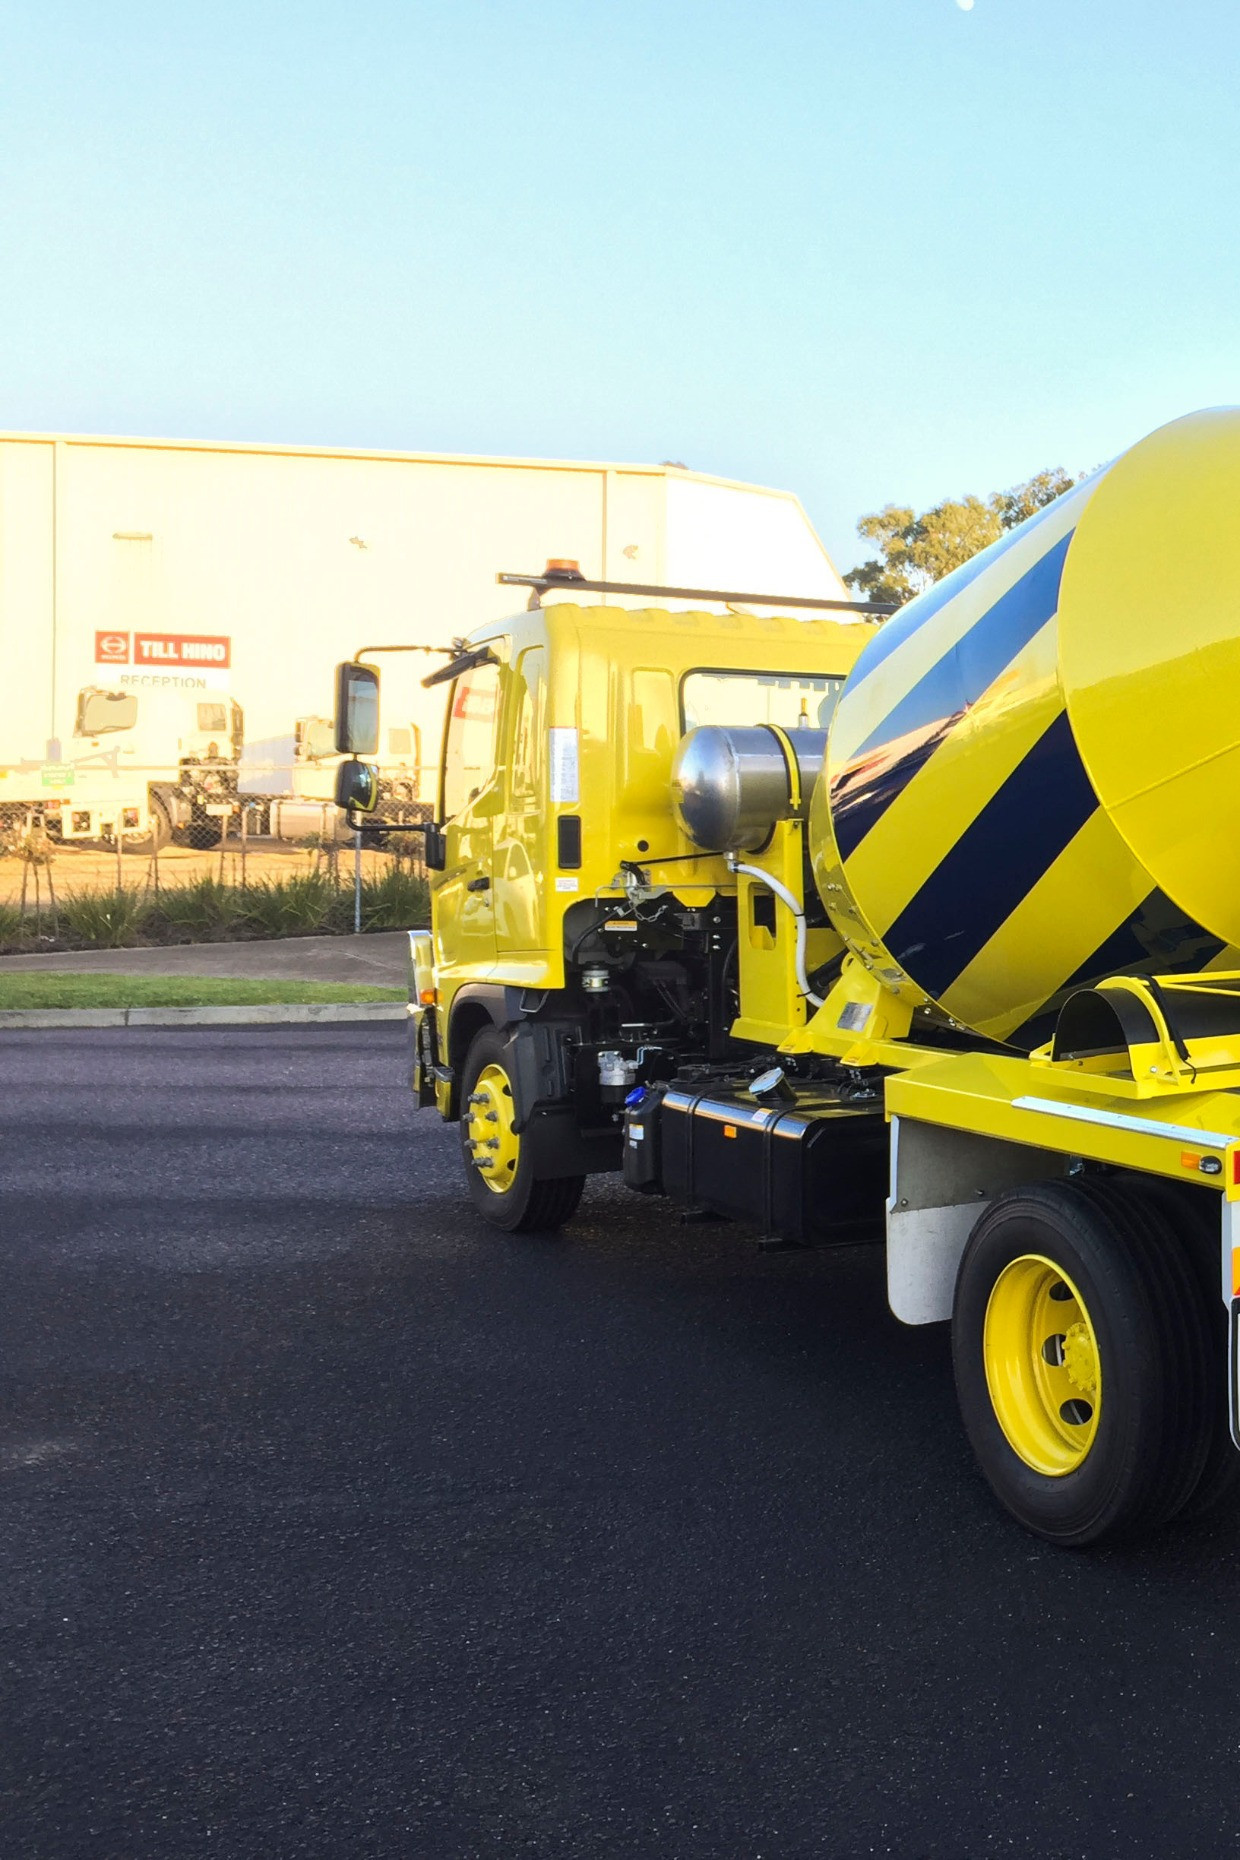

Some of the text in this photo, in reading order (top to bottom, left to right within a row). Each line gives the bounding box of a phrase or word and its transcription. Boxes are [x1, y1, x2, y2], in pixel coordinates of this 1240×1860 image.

[140, 640, 226, 661] TILL HINO
[120, 674, 206, 689] RECEPTION
